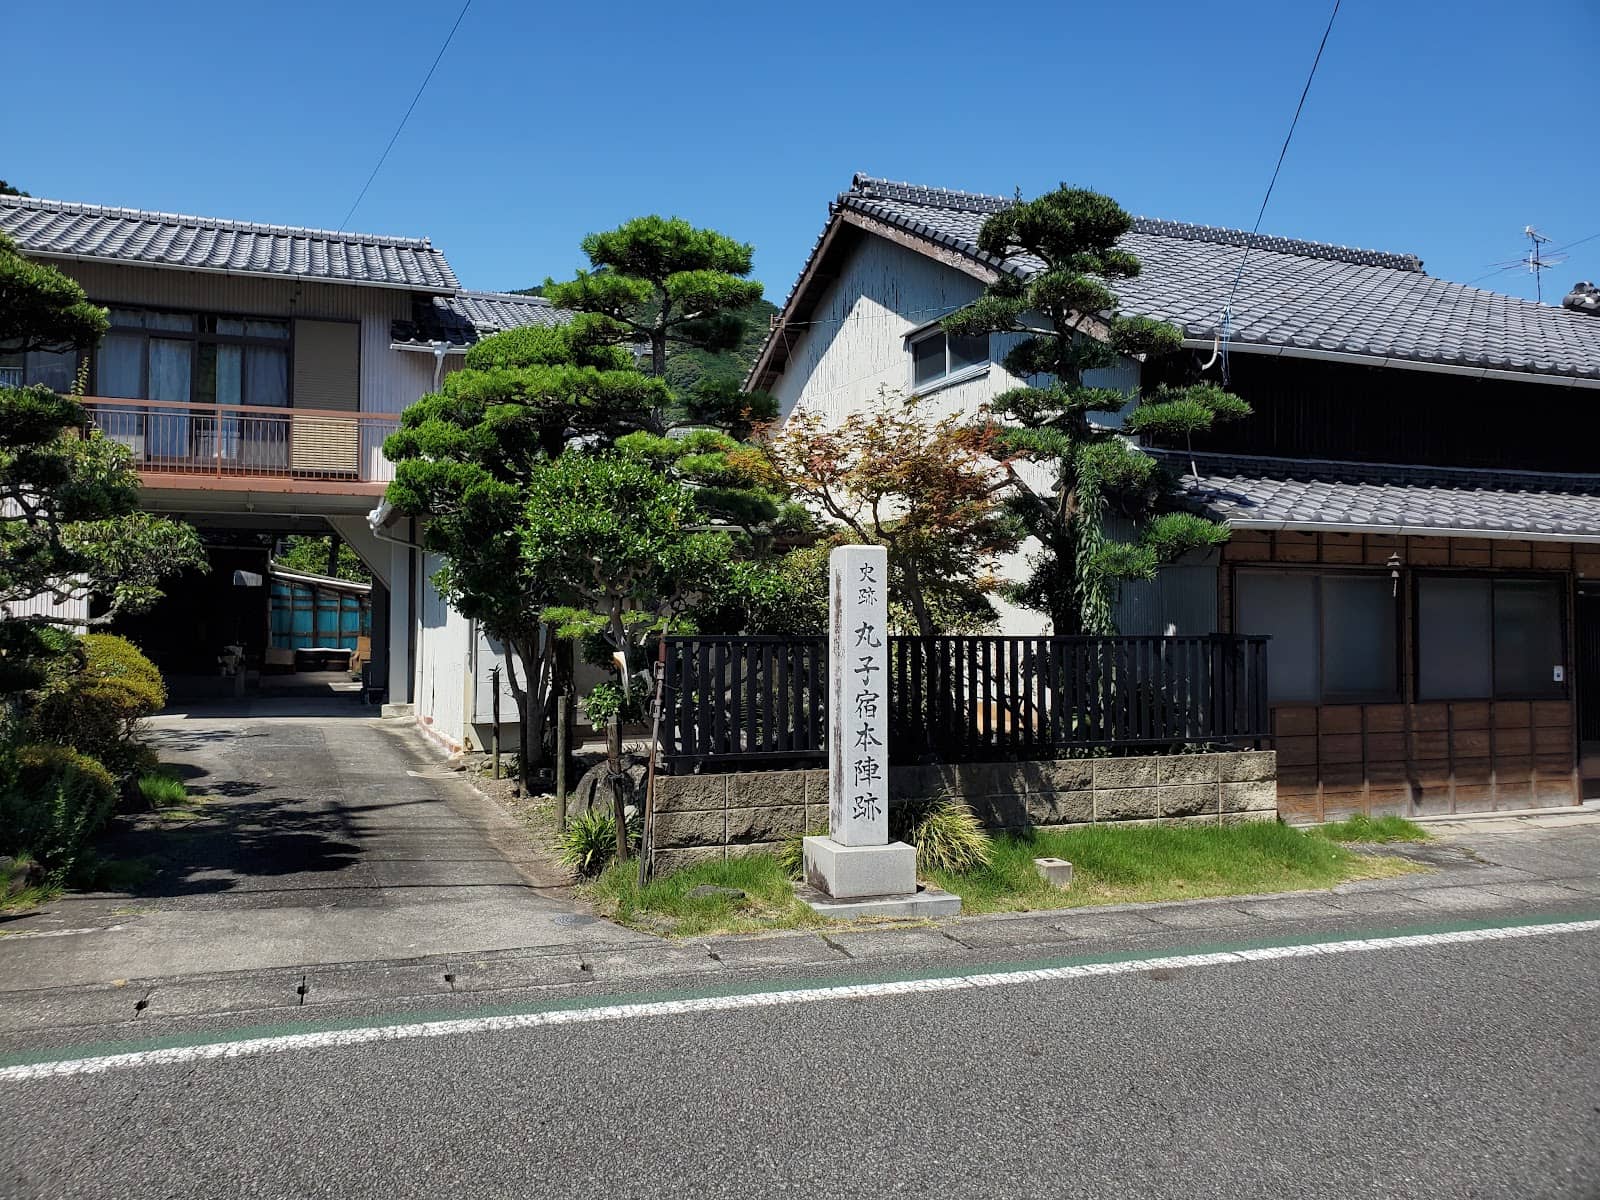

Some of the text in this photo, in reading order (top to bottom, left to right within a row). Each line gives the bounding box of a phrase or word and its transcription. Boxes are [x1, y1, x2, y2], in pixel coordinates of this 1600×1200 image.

[852, 562, 882, 821] 史跡 丸子宿本陣跡
